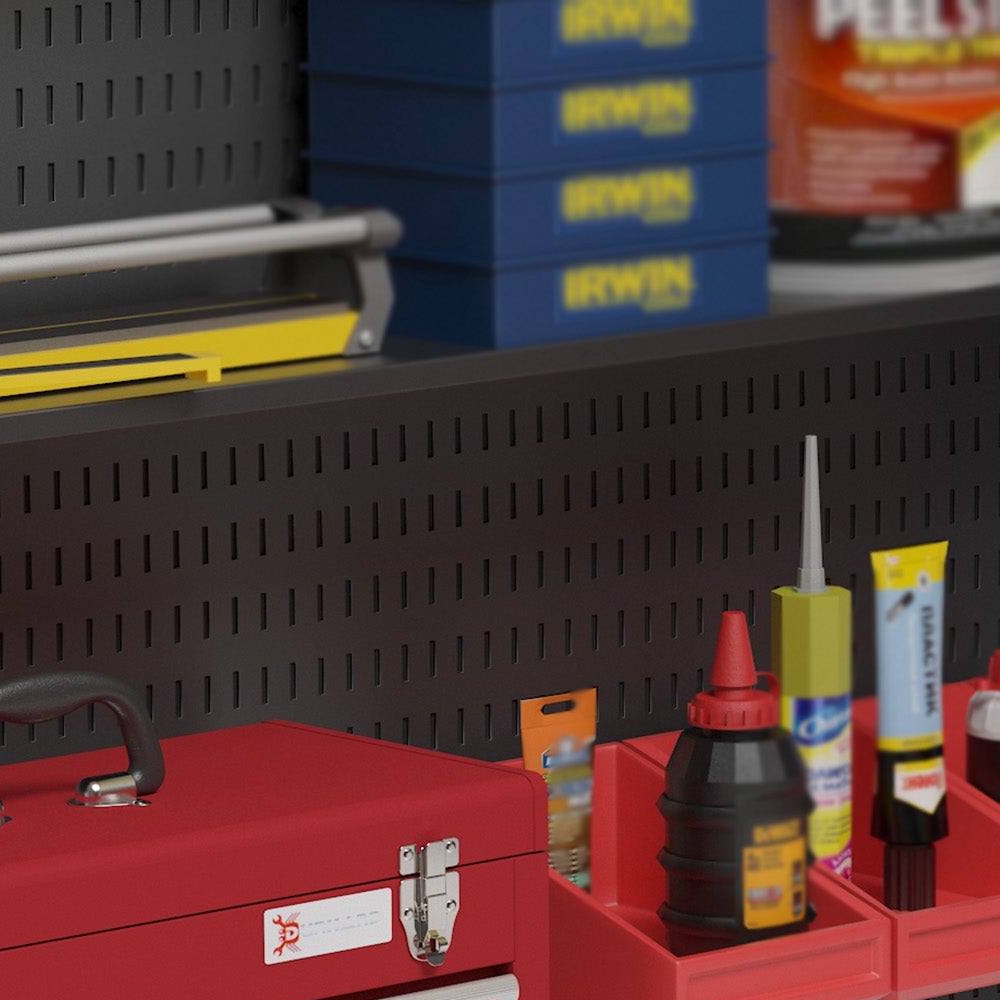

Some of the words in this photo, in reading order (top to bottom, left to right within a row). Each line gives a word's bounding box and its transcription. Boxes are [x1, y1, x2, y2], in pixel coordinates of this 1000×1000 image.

[814, 0, 1000, 41] PEELS
[562, 79, 694, 133] IRWIN
[562, 167, 694, 222] IRWIN
[563, 255, 695, 311] IRWIN
